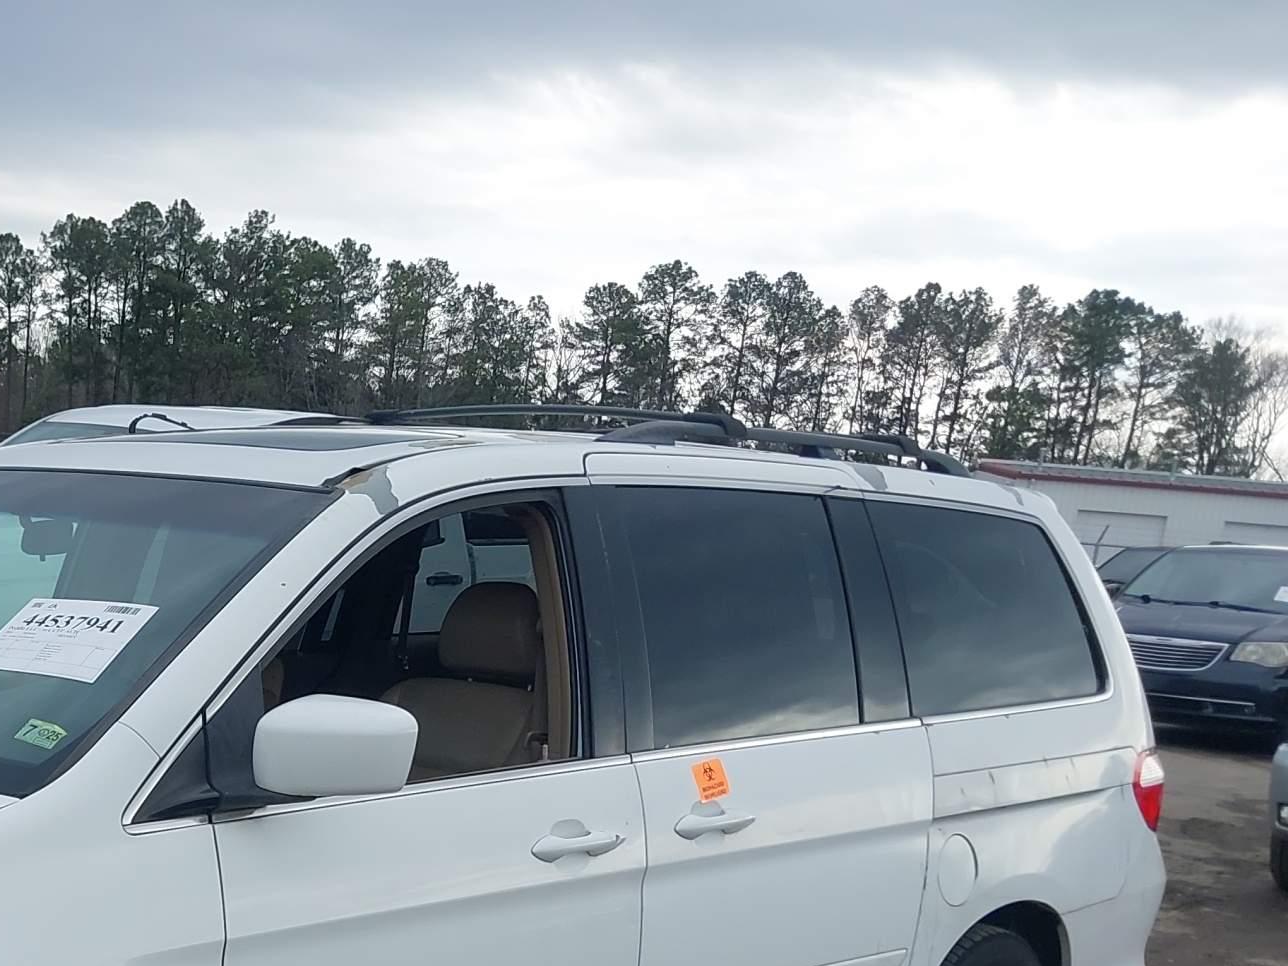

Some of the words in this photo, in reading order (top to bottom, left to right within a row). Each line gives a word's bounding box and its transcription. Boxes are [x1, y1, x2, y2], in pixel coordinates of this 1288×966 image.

[23, 614, 124, 633] 44537941
[23, 724, 38, 736] 7
[46, 730, 63, 741] 25
